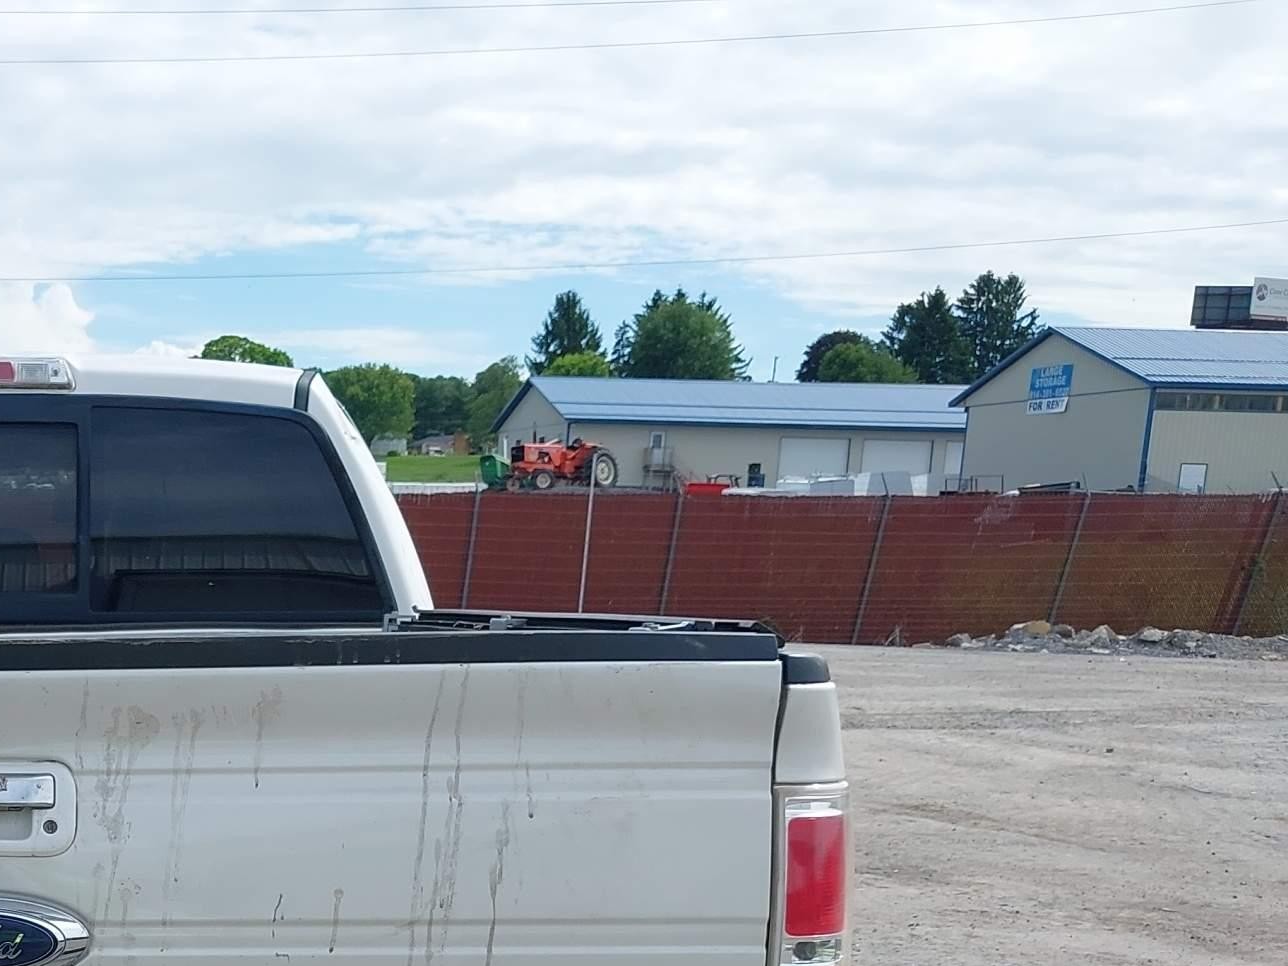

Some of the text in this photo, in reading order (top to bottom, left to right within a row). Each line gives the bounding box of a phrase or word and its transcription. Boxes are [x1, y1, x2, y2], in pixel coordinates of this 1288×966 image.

[1041, 366, 1063, 377] LARGE
[1035, 375, 1066, 388] STORAGE
[1028, 399, 1065, 411] FOR RENT
